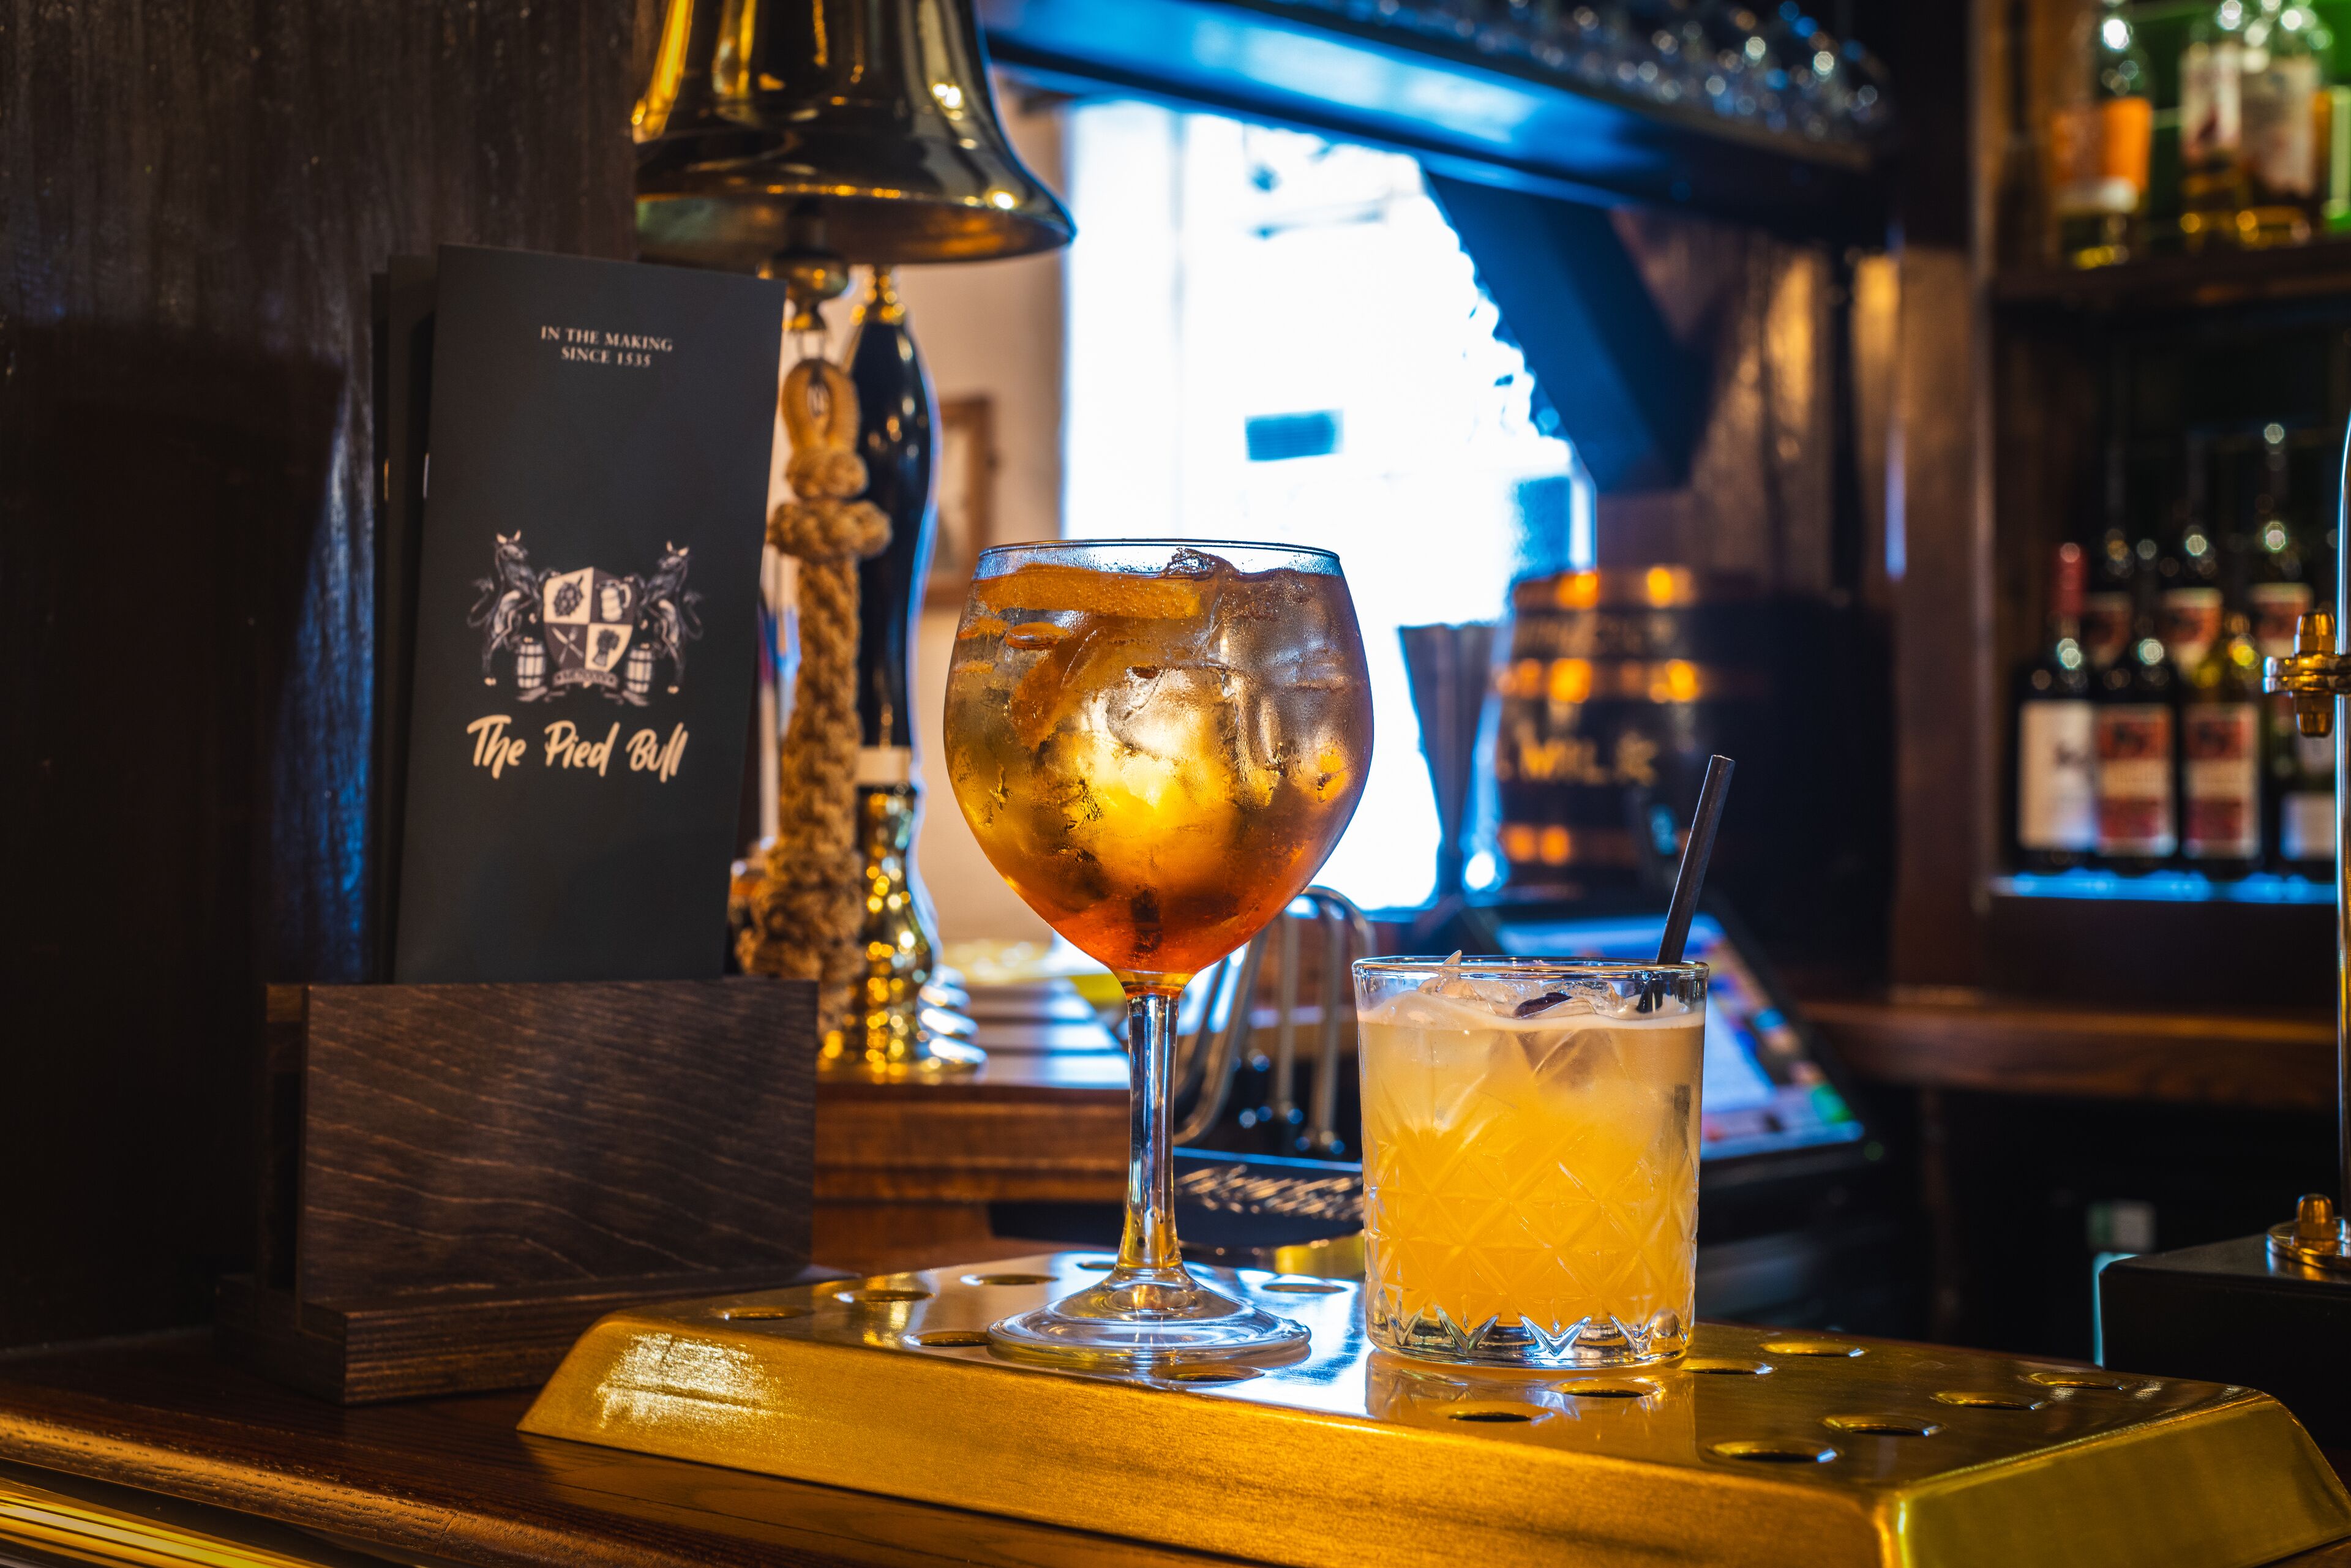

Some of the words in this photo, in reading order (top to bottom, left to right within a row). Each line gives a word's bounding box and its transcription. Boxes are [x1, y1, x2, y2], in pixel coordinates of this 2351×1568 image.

[541, 325, 560, 340] IN
[565, 328, 599, 345] THE
[604, 332, 673, 352] MAKING
[561, 346, 611, 364] SINCE
[617, 352, 651, 367] 1535
[467, 715, 527, 779] The
[544, 720, 620, 778] Pied
[625, 722, 689, 783] Bull
